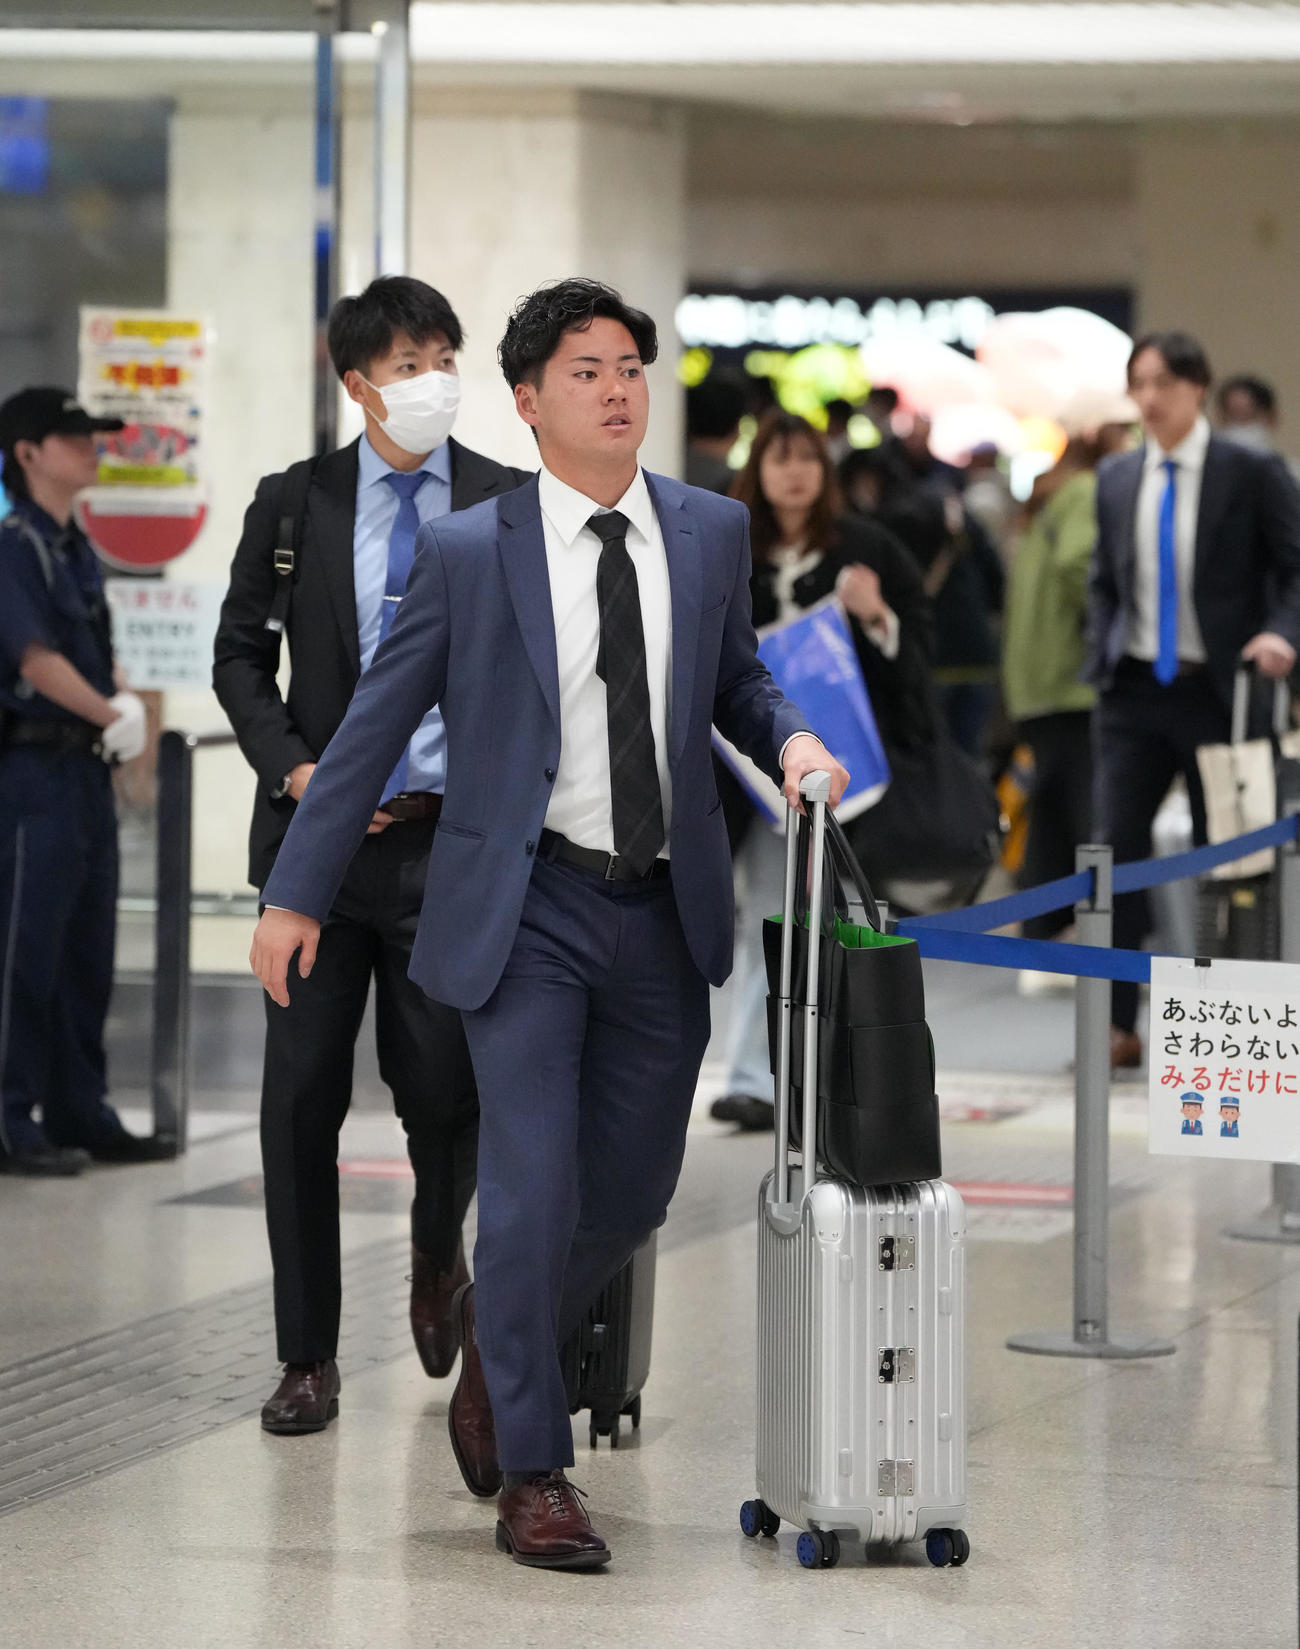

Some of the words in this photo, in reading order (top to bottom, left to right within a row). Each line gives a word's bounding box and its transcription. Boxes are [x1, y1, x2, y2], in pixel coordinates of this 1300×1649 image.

[1162, 997, 1298, 1028] あぶないよ
[1164, 1030, 1299, 1060] さわらない
[1160, 1064, 1298, 1094] みるだけに
